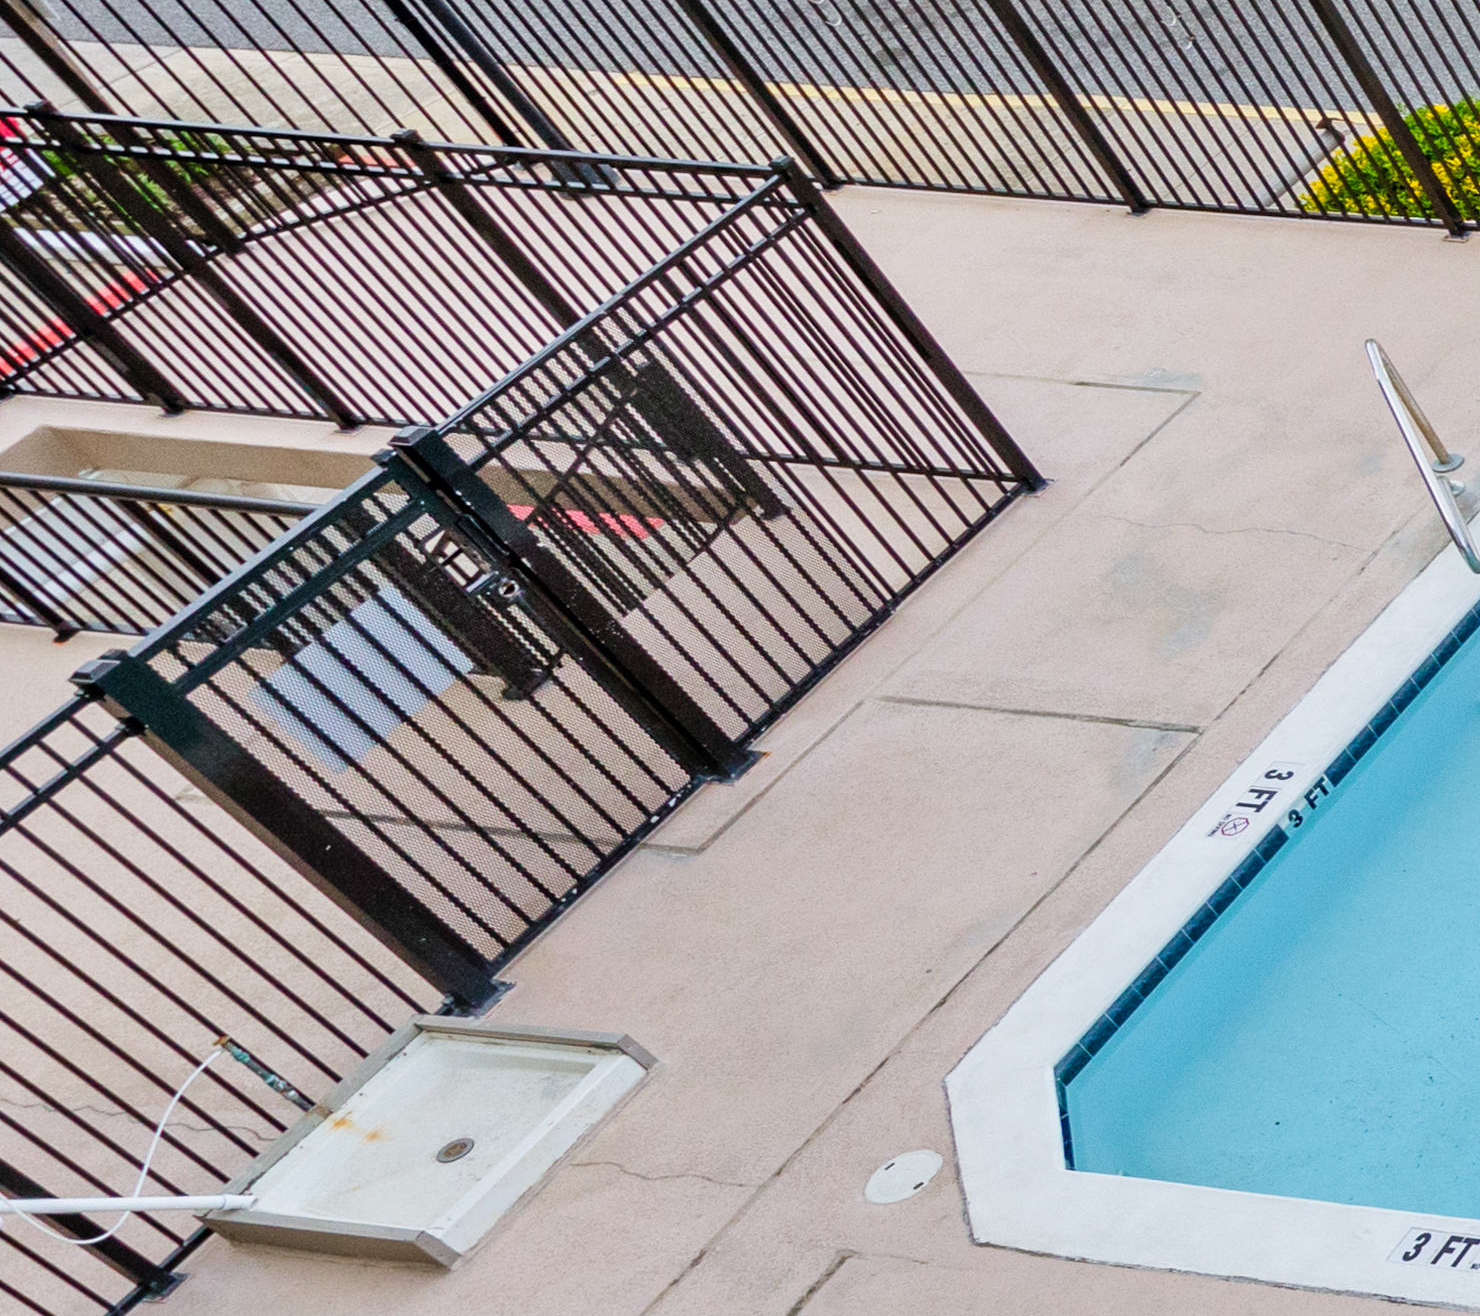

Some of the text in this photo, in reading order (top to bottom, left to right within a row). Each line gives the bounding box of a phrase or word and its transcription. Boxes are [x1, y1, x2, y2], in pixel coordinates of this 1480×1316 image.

[1235, 769, 1294, 813] 3 FT
[1288, 776, 1330, 829] 3 FT
[1402, 1233, 1432, 1261] 3
